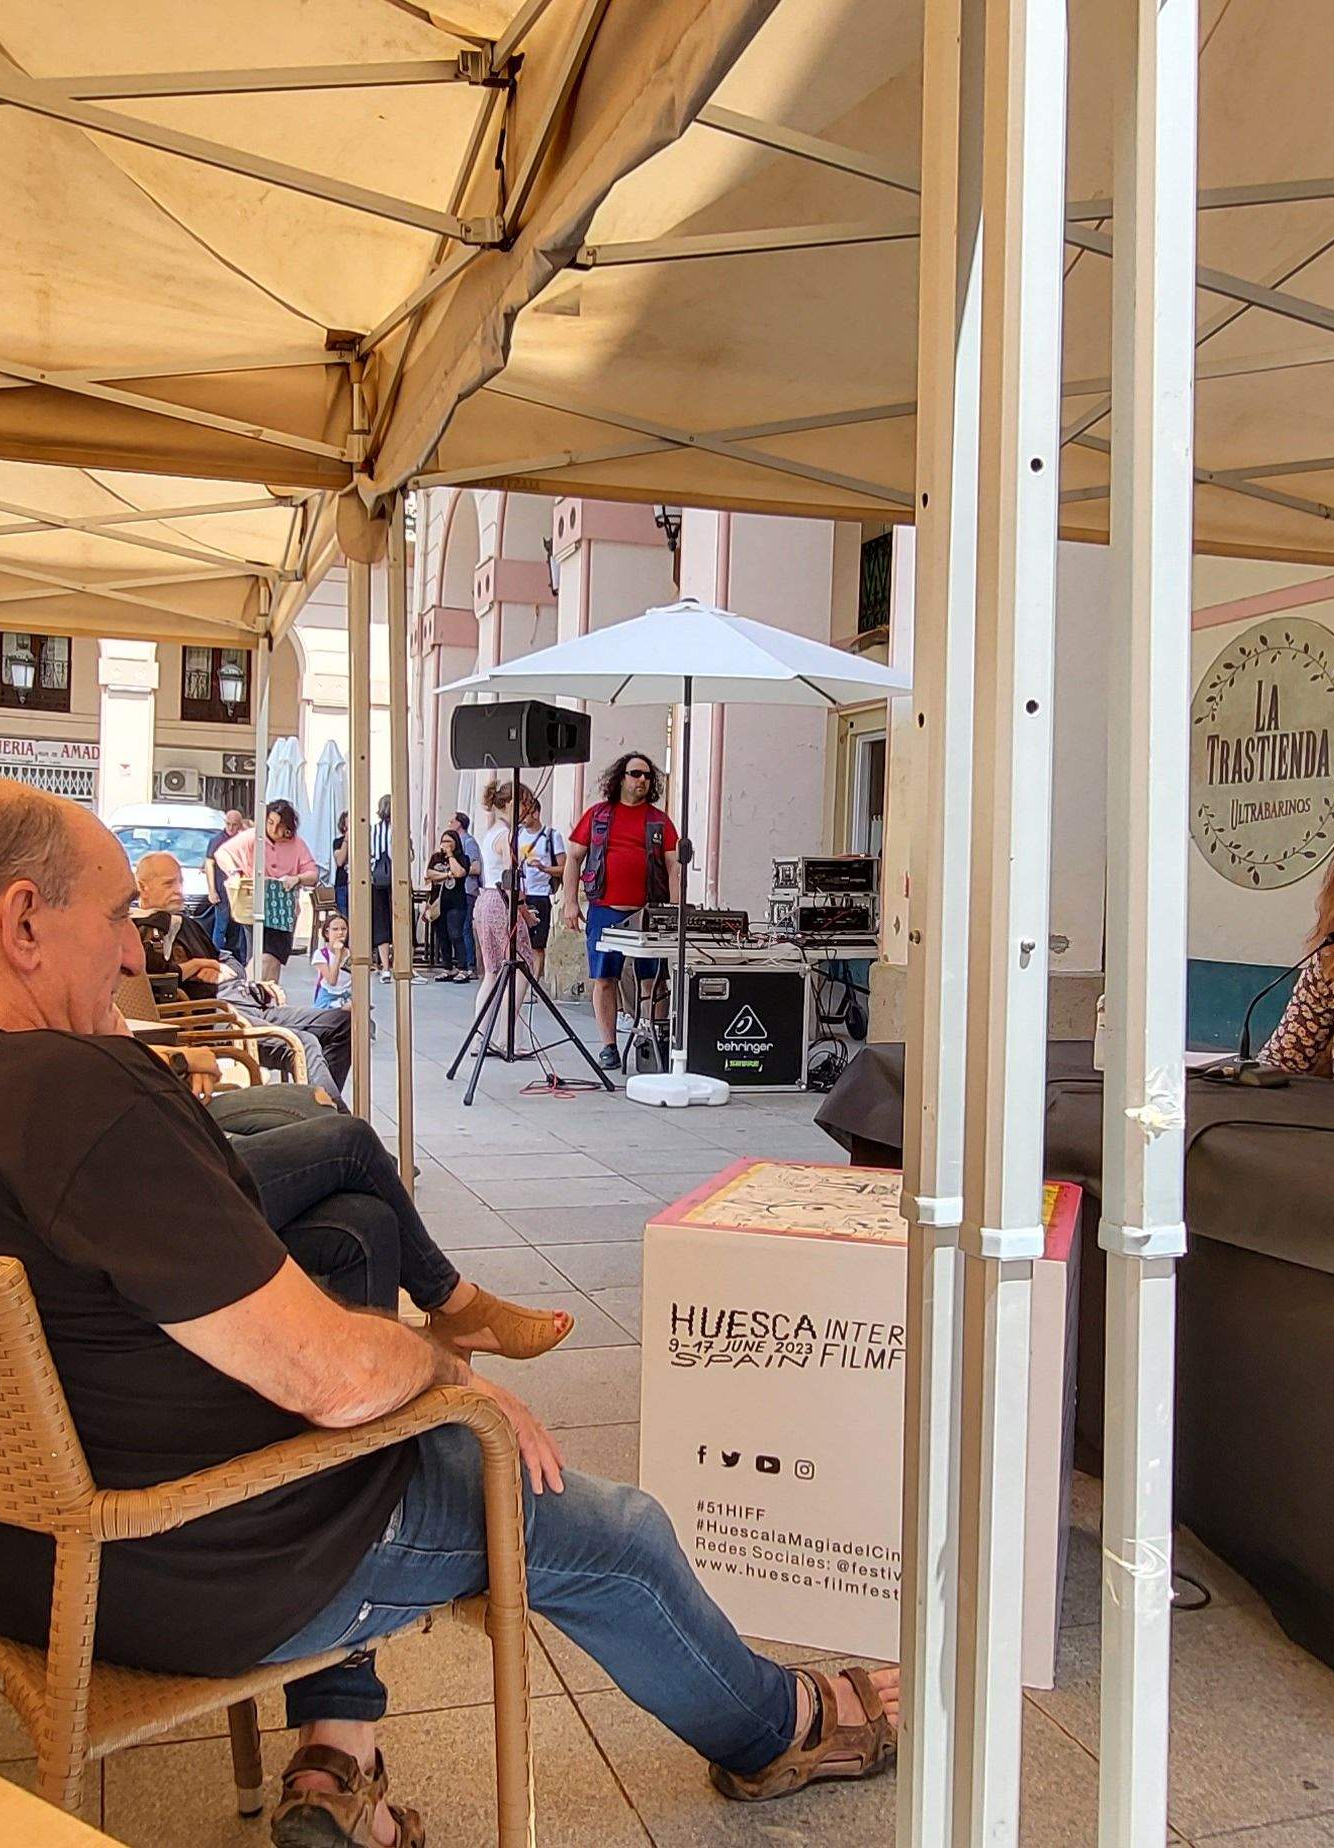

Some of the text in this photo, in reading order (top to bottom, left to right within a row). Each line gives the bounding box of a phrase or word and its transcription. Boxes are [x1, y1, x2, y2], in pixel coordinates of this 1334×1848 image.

[1254, 680, 1280, 732] LA
[61, 744, 100, 760] AMAD
[1206, 729, 1331, 785] TRASTIENDA
[717, 1040, 773, 1054] behringer
[672, 1303, 904, 1346] HUESCA INTER
[668, 1338, 813, 1354] 9-17 JUNE 2023
[820, 1343, 906, 1370] FILMF
[670, 1352, 809, 1369] SPAIN
[697, 1499, 766, 1521] #51HIFF
[695, 1536, 902, 1582] Redes Sociales: @festiv
[694, 1557, 900, 1601] www.huesca-filmfest
